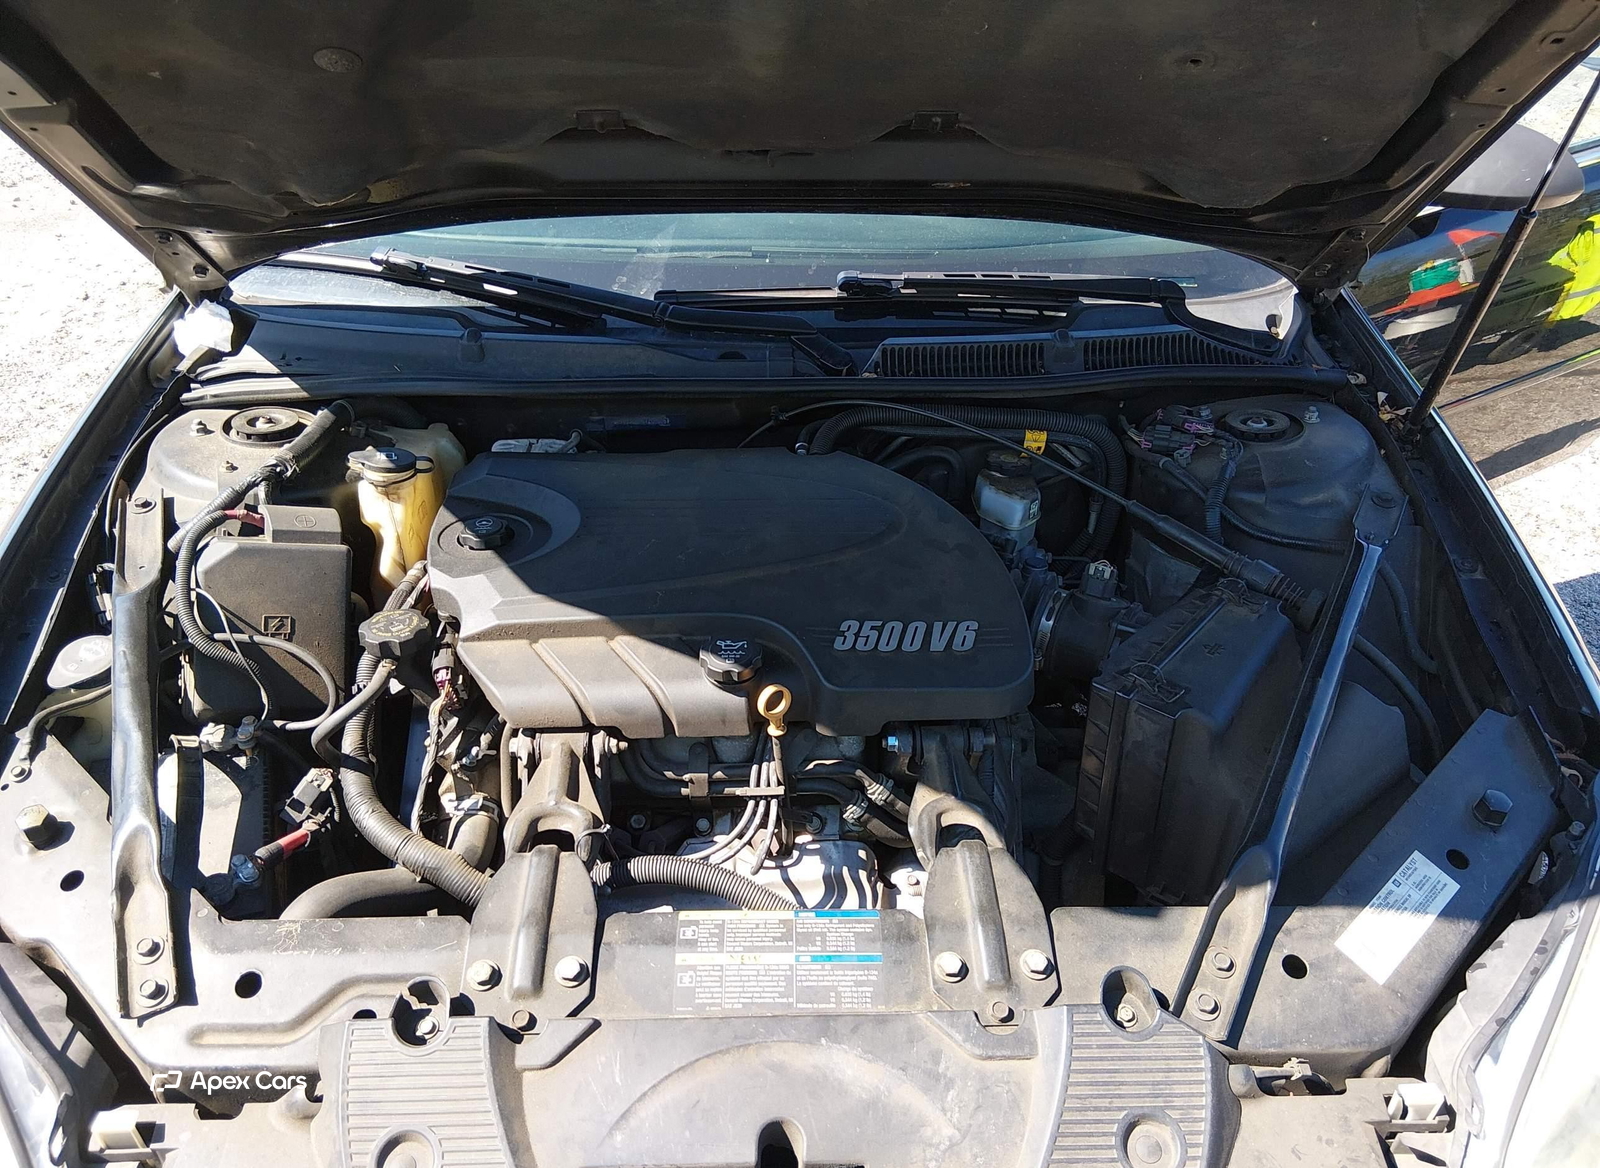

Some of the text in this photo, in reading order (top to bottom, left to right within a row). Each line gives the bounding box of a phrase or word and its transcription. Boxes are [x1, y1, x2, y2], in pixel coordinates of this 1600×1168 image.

[834, 619, 979, 652] 3500 V6
[1399, 857, 1418, 878] CATALYST
